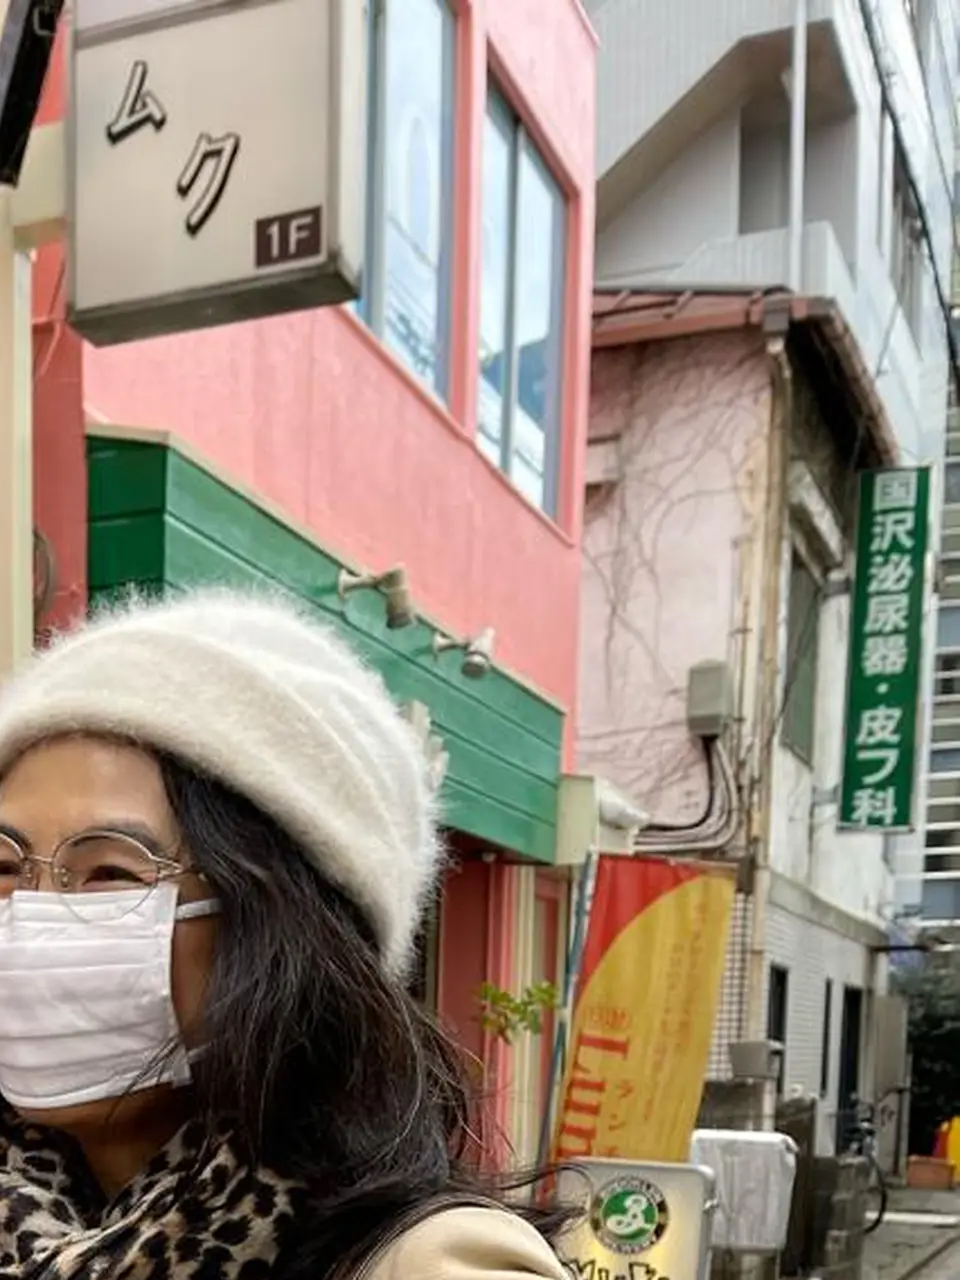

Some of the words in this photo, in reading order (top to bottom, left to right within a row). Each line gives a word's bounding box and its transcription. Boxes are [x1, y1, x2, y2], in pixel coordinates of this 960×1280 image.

[106, 59, 240, 240] ムク
[266, 214, 314, 259] 1F
[557, 1030, 630, 1158] Lun
